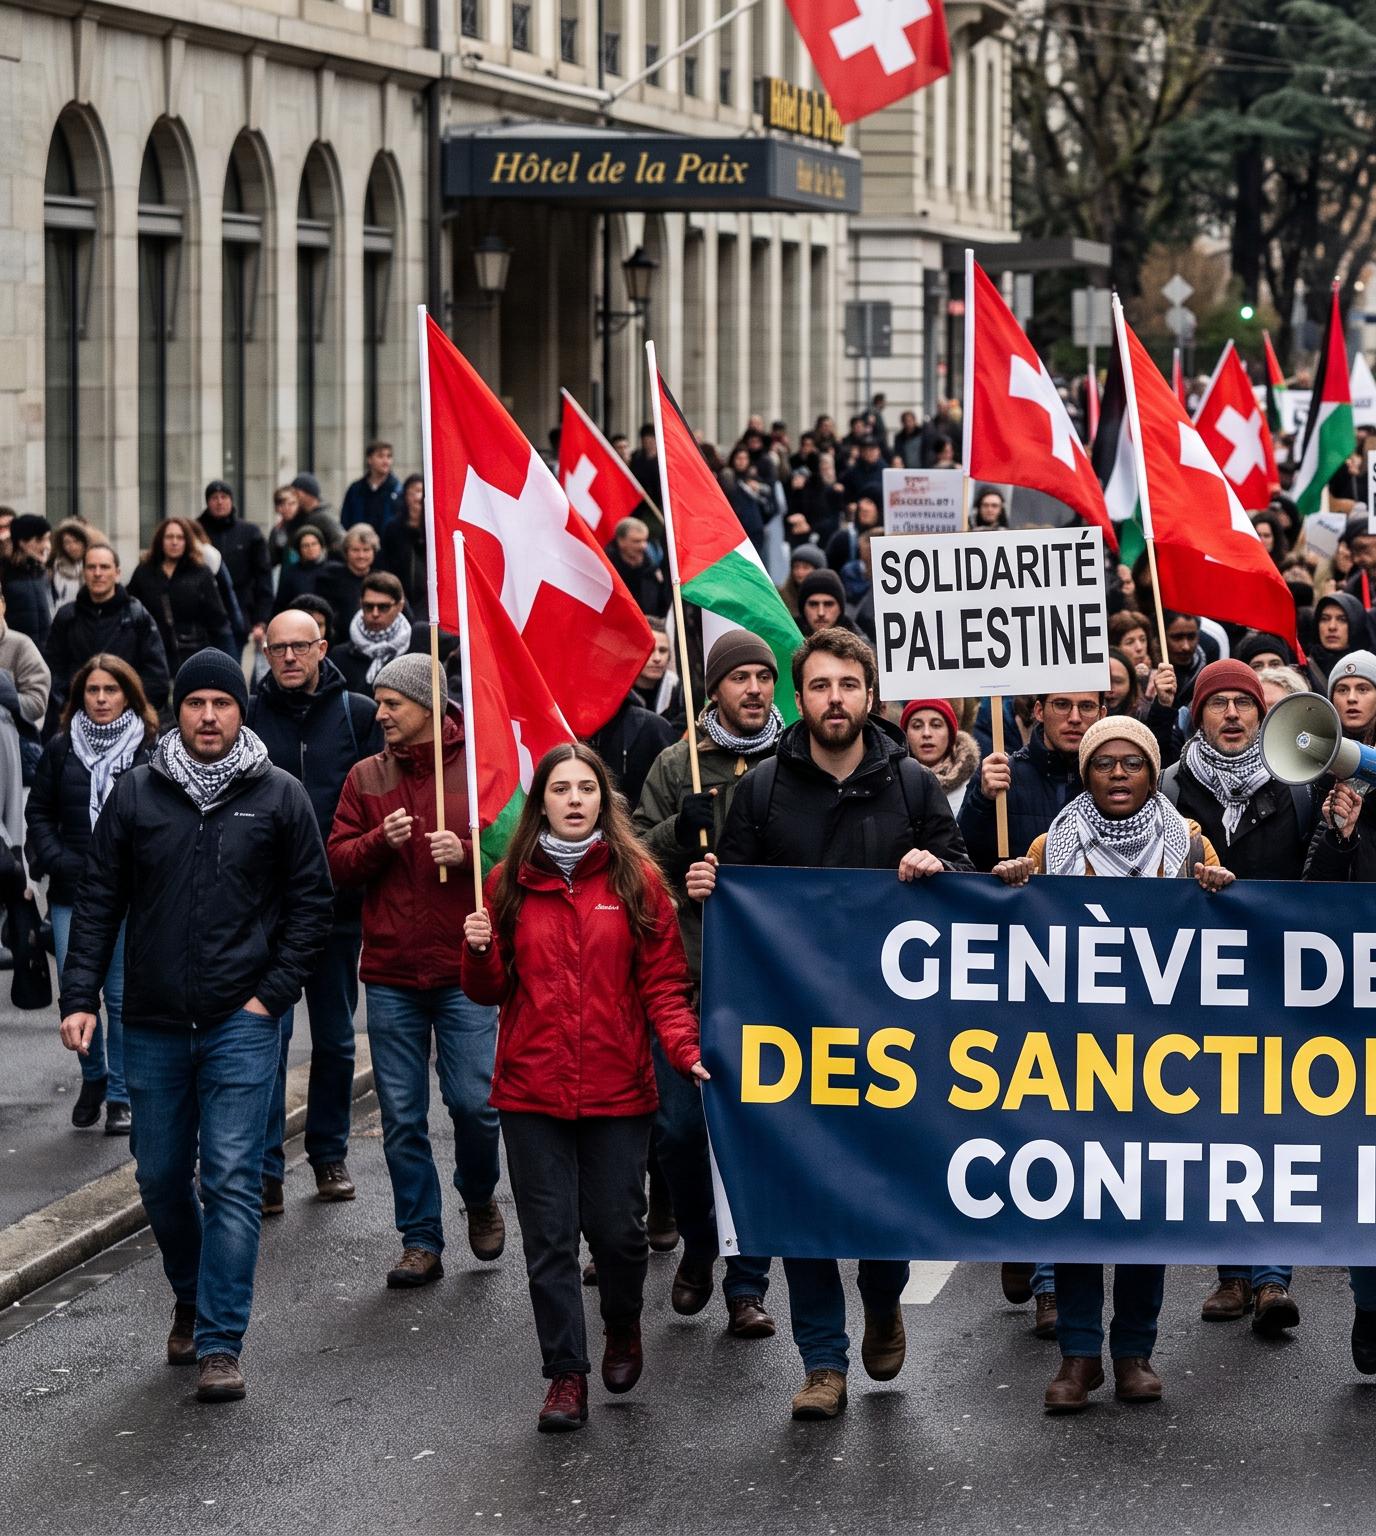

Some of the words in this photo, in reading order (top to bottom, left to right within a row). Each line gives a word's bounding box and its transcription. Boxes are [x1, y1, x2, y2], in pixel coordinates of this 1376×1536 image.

[492, 152, 580, 184] Hôtel
[587, 153, 626, 184] de
[635, 153, 666, 184] la
[675, 153, 749, 184] Paix
[880, 530, 1098, 595] SOLIDARITÉ
[883, 603, 1104, 673] PALESTINE
[881, 903, 1249, 1007] GENÈVE
[741, 1024, 917, 1109] DES
[947, 1137, 1322, 1224] CONTRE
